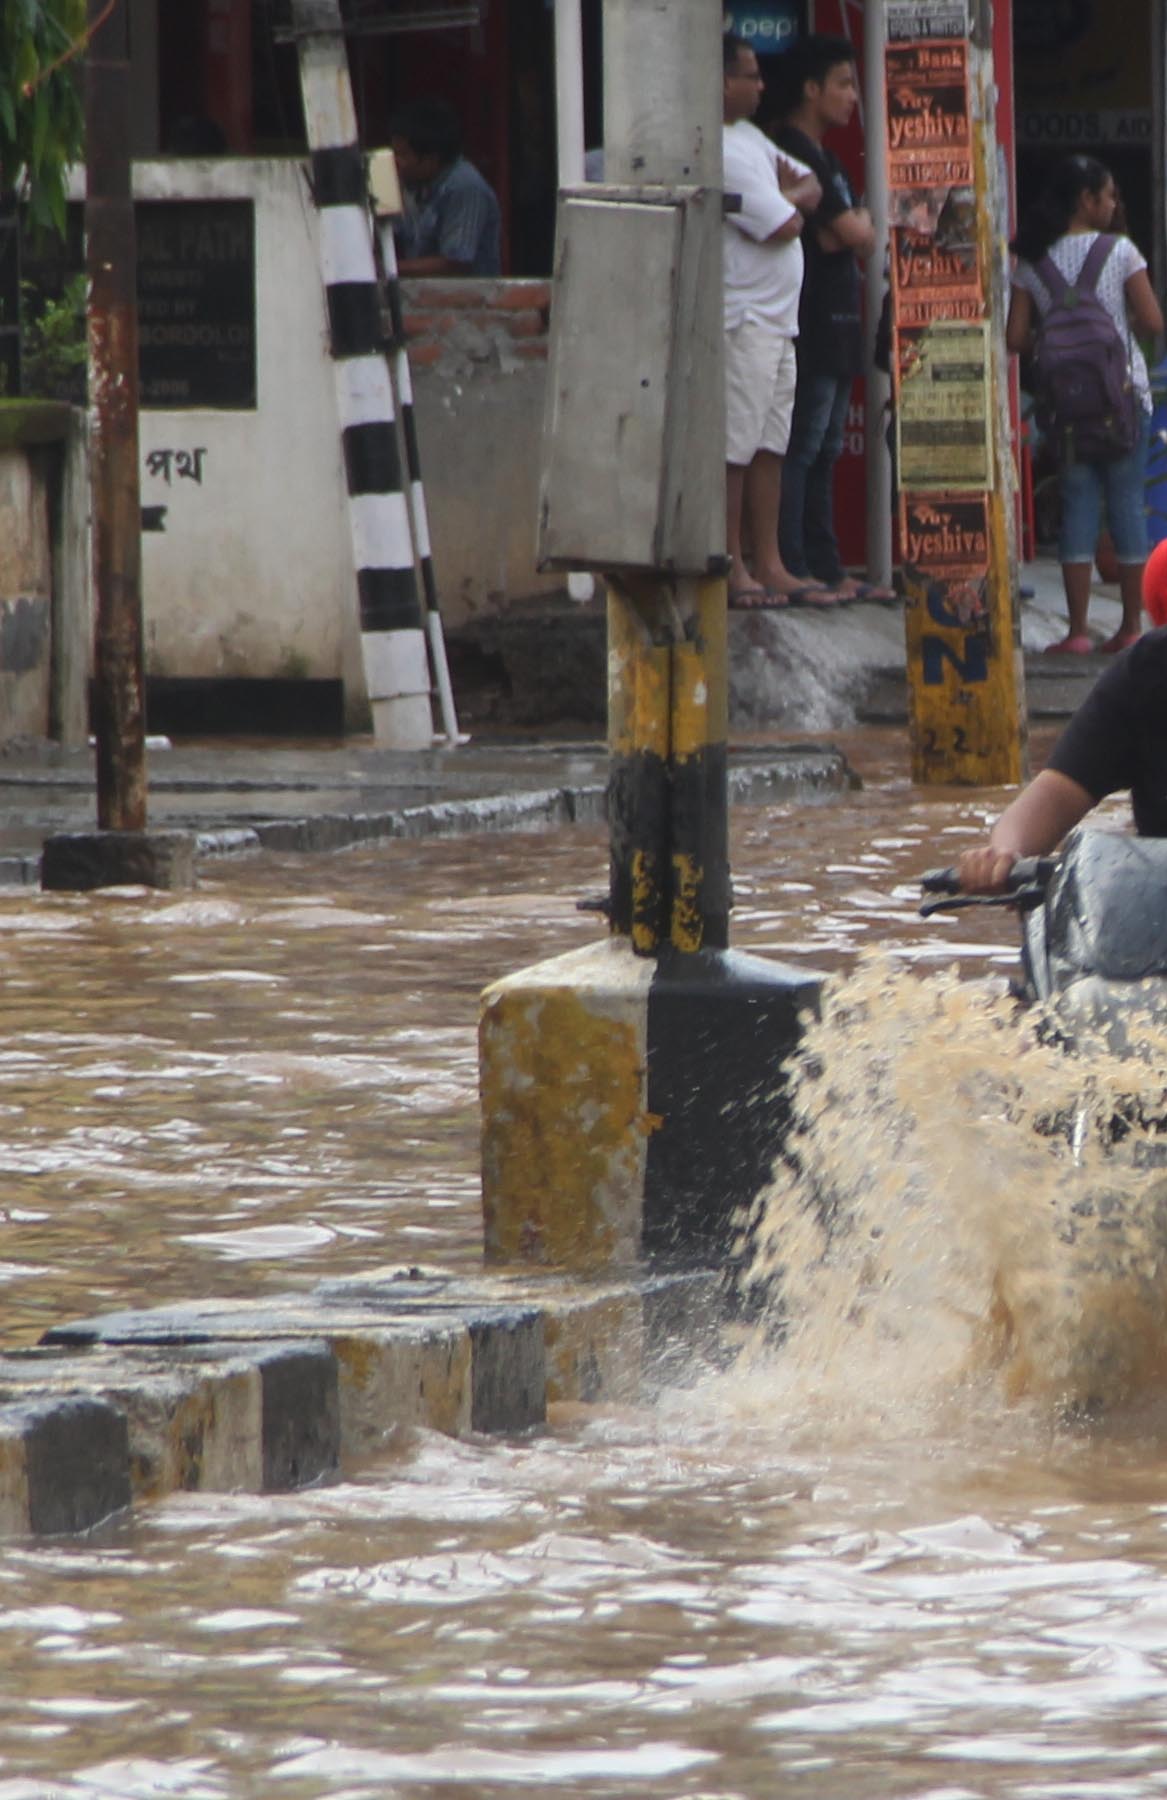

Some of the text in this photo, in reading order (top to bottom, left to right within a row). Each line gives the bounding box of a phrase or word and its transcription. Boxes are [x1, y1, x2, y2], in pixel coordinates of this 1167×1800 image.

[918, 47, 963, 68] Bank
[892, 108, 966, 147] yeshiva
[1025, 113, 1106, 144] OODS,
[900, 246, 970, 286] yeshiv
[146, 447, 208, 487] পথ
[910, 525, 985, 562] yeshiva
